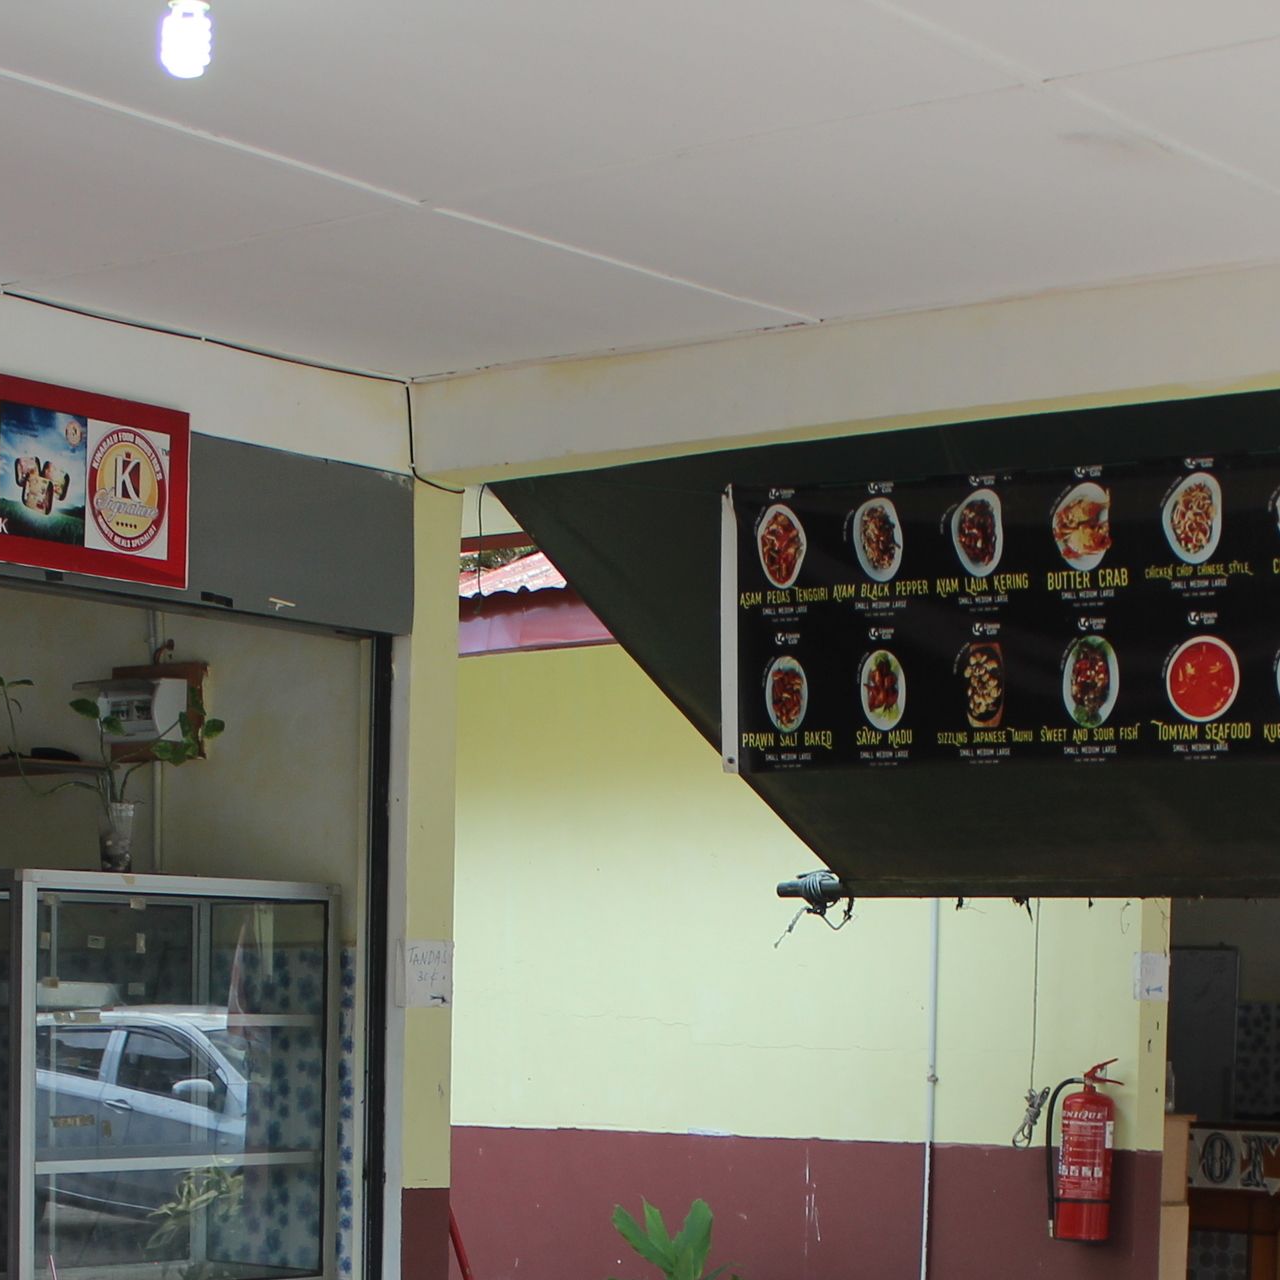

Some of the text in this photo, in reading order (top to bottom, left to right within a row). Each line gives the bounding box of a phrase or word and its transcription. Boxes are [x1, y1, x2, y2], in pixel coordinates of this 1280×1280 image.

[118, 432, 135, 443] FOOD
[115, 456, 141, 501] K
[0, 517, 8, 534] K
[1047, 568, 1129, 590] BUTTER CRAB
[1145, 563, 1173, 580] CHICKEN
[1229, 560, 1254, 576] STYLE
[833, 580, 929, 602] AYAM BLACK PEPPER
[936, 578, 959, 597] AYAM
[994, 573, 1029, 593] KERING
[740, 592, 762, 609] ASAM
[742, 731, 832, 750] PRAWN SALT BAKED
[856, 726, 912, 748] SAYAP MADU
[937, 732, 968, 746] SIZZLING
[972, 730, 1006, 744] JAPANESE
[1040, 722, 1140, 744] SWEET AND SOUR FISH
[1151, 719, 1251, 744] TOMYAM SEAFOOD
